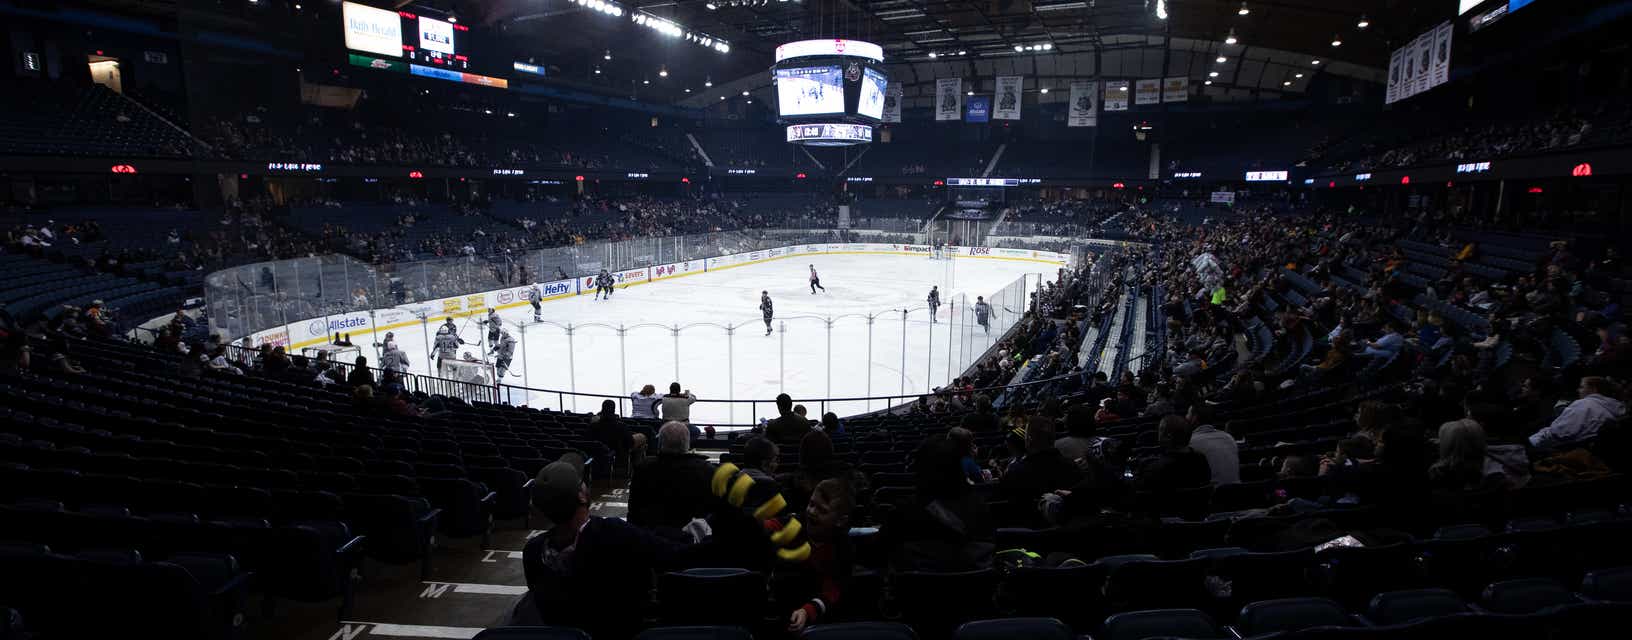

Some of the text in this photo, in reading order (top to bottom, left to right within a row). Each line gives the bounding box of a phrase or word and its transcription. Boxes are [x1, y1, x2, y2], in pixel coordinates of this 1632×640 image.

[545, 283, 569, 295] Hefty
[329, 317, 367, 330] Allstate
[419, 583, 449, 598] M
[328, 623, 367, 640] N
